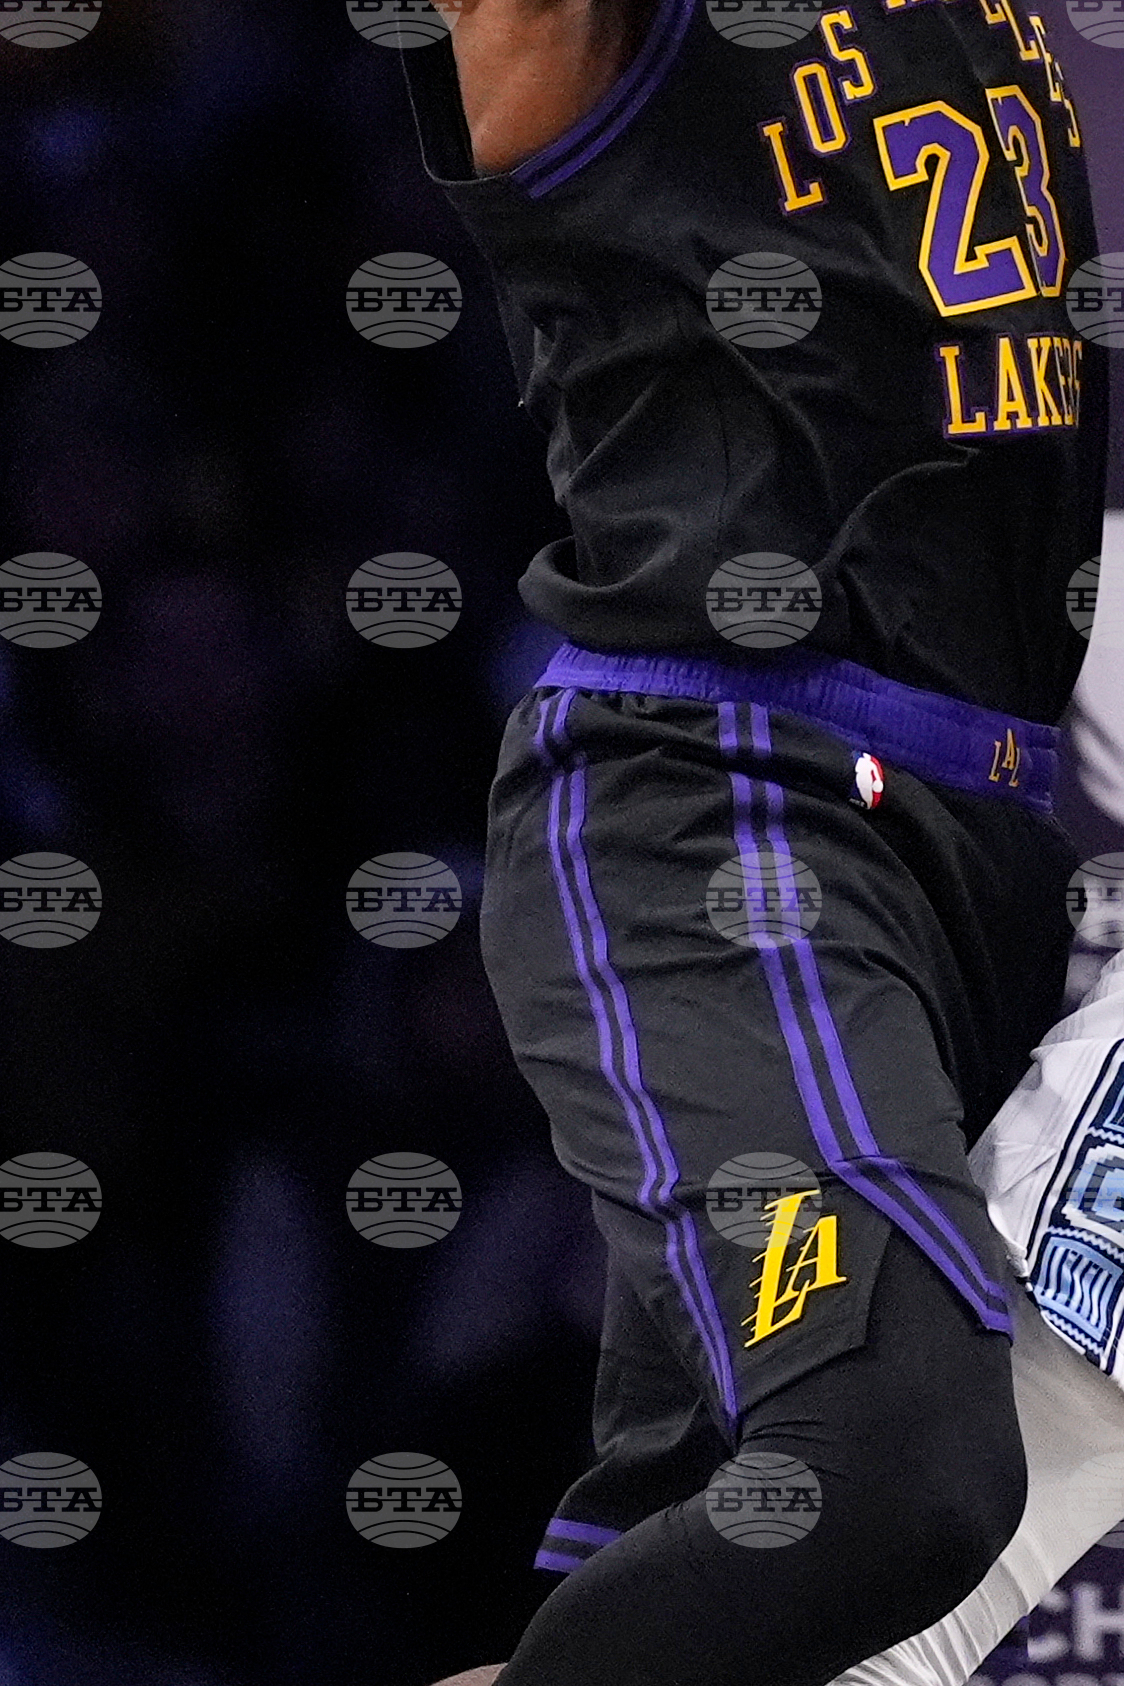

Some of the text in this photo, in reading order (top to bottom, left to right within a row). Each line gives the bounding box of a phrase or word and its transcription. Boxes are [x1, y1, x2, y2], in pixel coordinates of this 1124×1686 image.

[760, 7, 878, 214] LOS
[872, 83, 1066, 318] 23
[740, 1189, 847, 1348] LA
